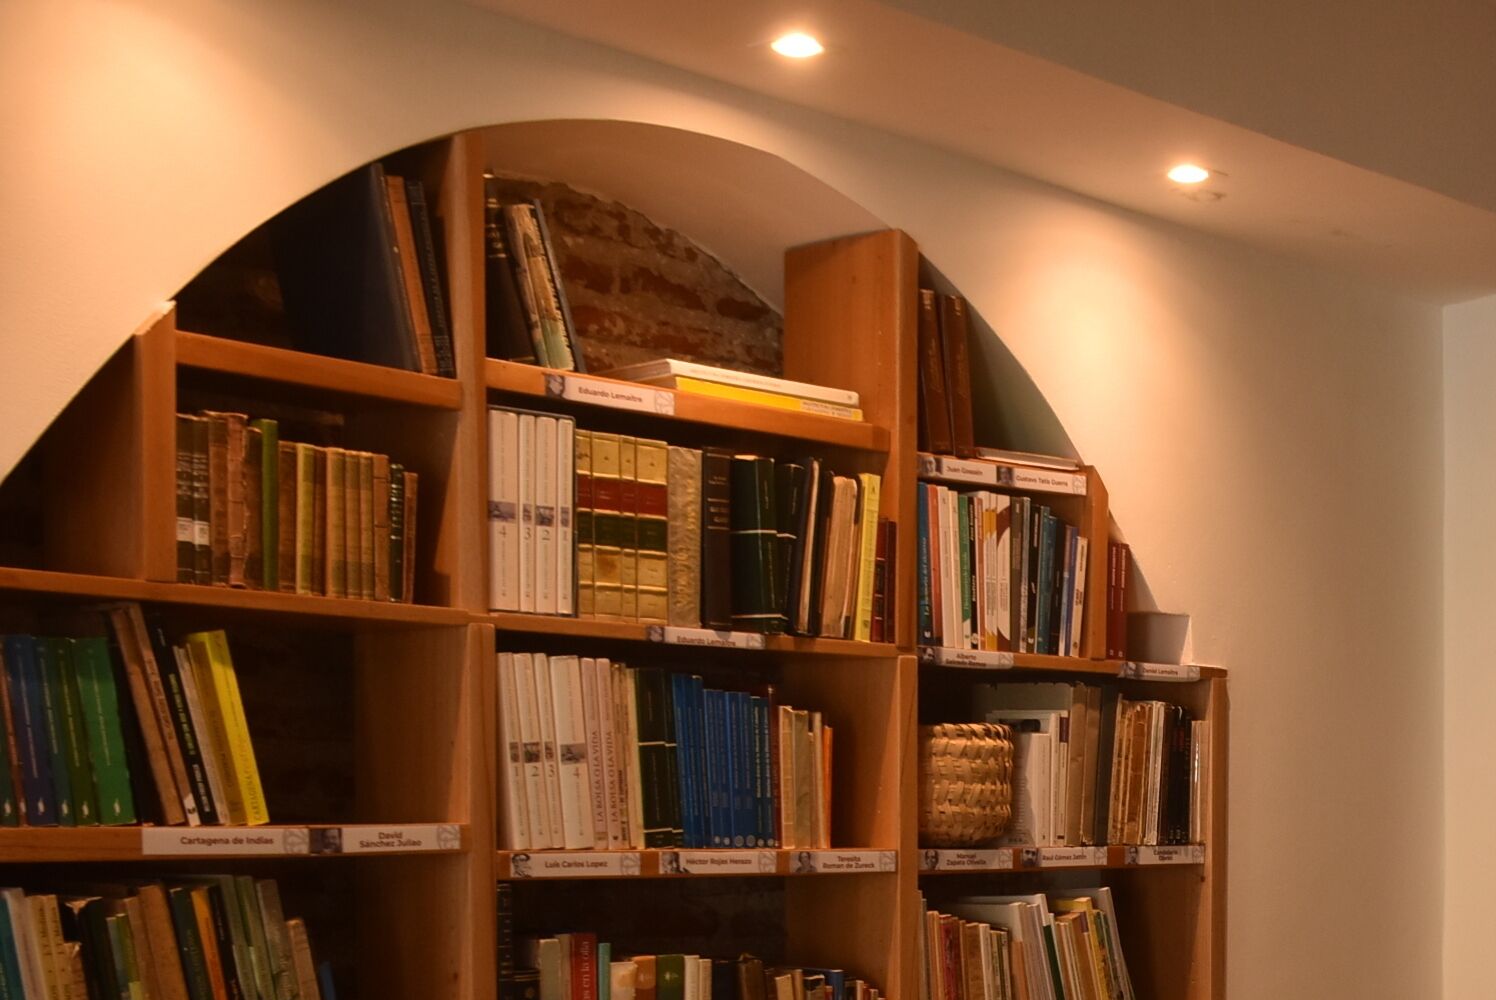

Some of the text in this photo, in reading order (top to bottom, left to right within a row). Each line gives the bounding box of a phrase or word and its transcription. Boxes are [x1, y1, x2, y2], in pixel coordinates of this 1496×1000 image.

[578, 387, 609, 398] Eduardo
[378, 831, 403, 840] David
[180, 836, 274, 847] Cartagena de Indias
[544, 860, 560, 868] Luis
[562, 860, 584, 868] Carlos
[710, 858, 728, 867] Rojas
[579, 940, 590, 960] olla
[580, 974, 590, 988] en
